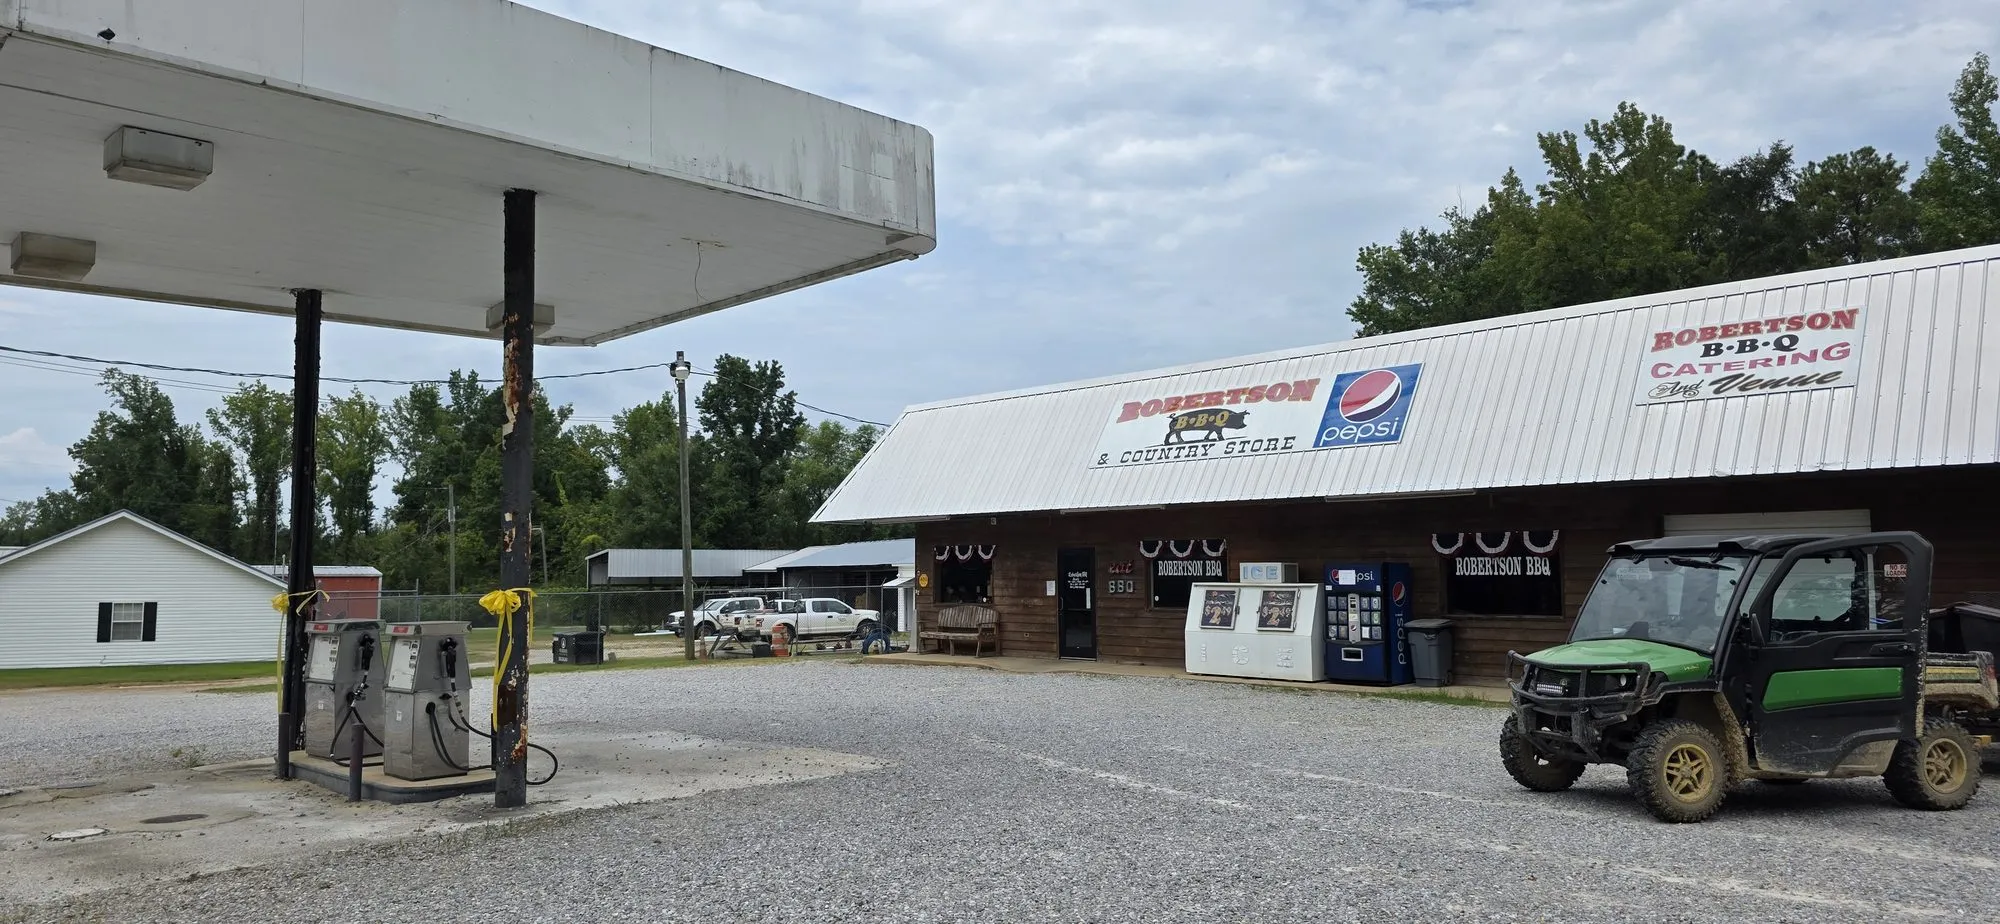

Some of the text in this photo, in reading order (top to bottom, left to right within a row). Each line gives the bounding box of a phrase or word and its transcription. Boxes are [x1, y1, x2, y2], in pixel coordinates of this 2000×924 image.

[1651, 308, 1859, 352] ROBERTSON
[1651, 342, 1850, 378] CATERING
[1648, 370, 1843, 399] And Venue
[1116, 378, 1320, 423] ROBERTSON
[1321, 417, 1399, 444] pepsi
[1097, 436, 1296, 465] & COUNTRY STORE
[1158, 560, 1222, 576] ROBERTSON BBQ
[1242, 565, 1279, 580] ICE
[1355, 571, 1374, 582] psi
[1455, 556, 1551, 576] ROBERTSON BBQ
[1395, 613, 1407, 664] pepsi
